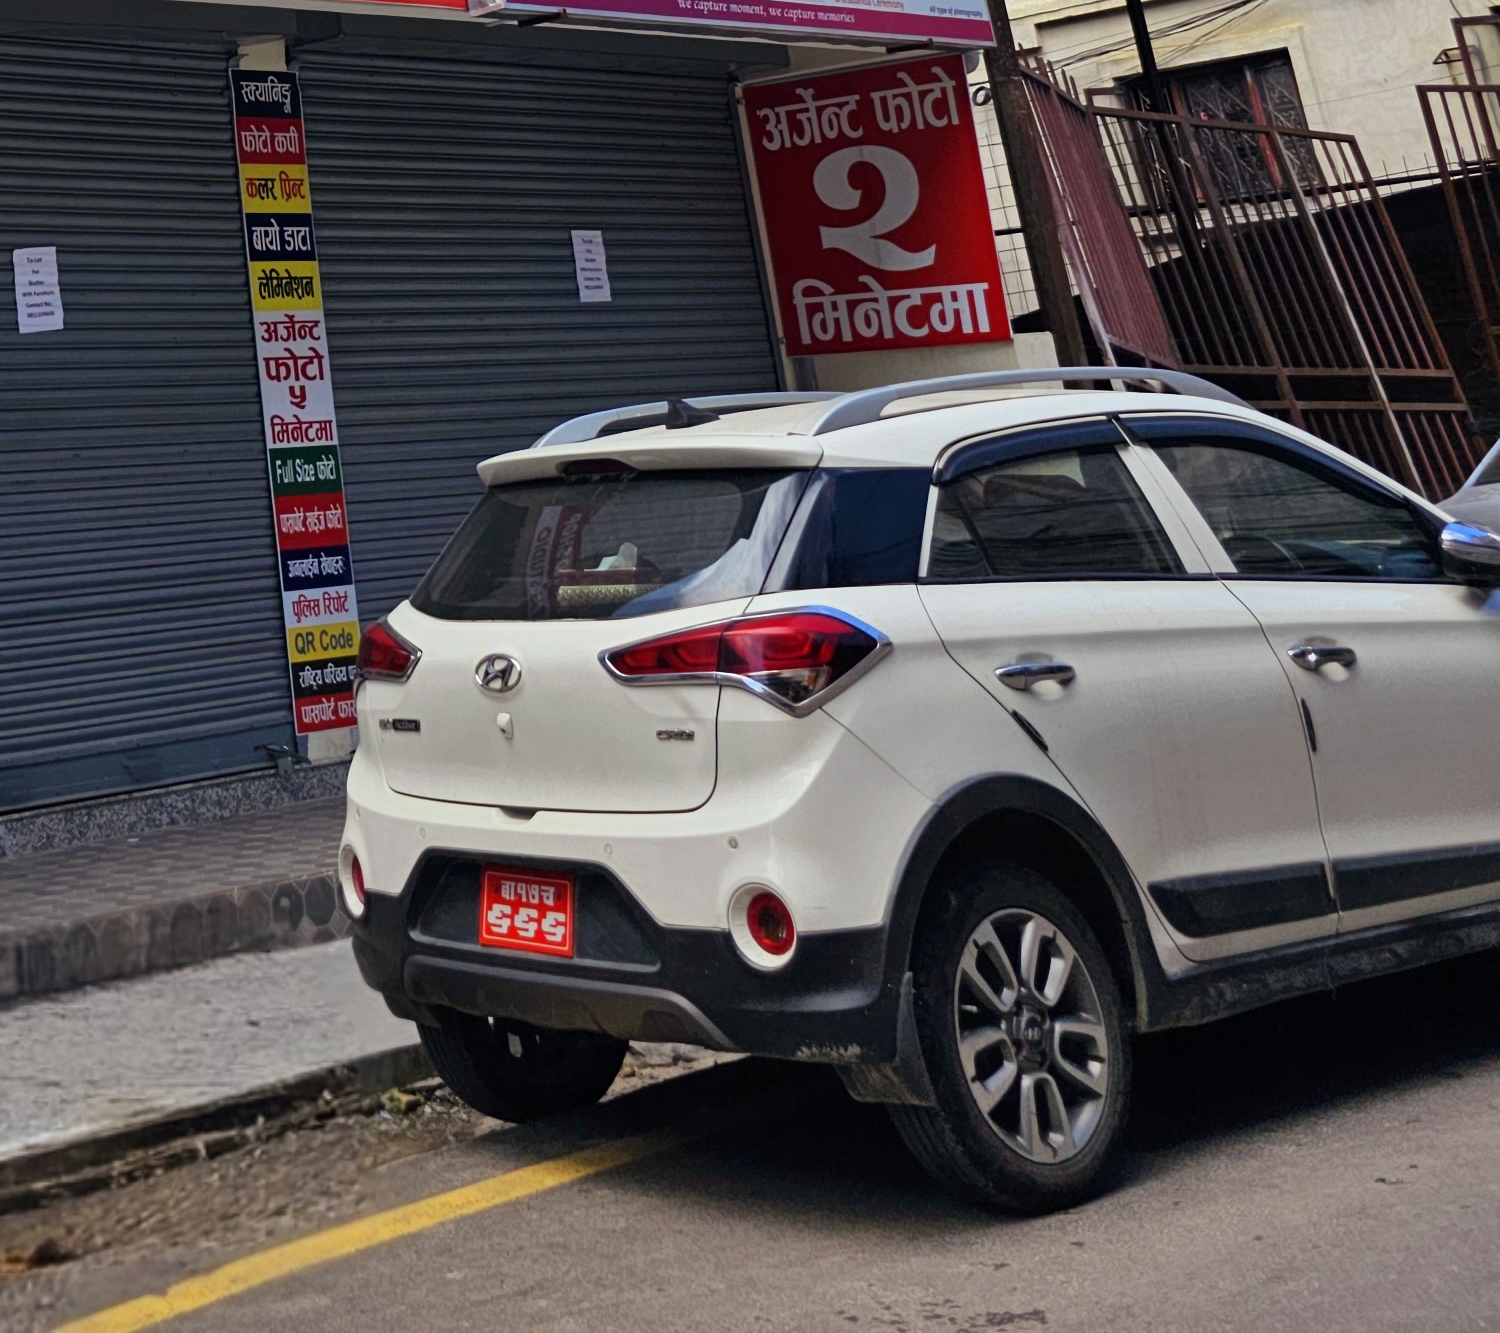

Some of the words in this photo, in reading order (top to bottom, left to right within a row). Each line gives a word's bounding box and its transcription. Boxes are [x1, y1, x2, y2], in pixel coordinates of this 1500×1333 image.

[694, 0, 727, 14] capture
[784, 8, 815, 21] capture
[756, 88, 863, 151] अर्जेन्ट
[870, 66, 959, 133] फोटो
[241, 125, 271, 153] फोटो
[274, 126, 299, 153] कपी
[245, 178, 277, 200] कलर
[279, 171, 305, 202] प्रिन्ट
[813, 145, 936, 271] २
[252, 218, 280, 251] बायो
[283, 227, 311, 251] डाटा
[258, 268, 314, 300] लेमिनेशन
[793, 275, 990, 345] मिनेटमा
[259, 314, 321, 343] अर्जेन्ट
[263, 347, 324, 382] फोटो
[289, 385, 307, 409] ५
[270, 414, 333, 444] मिनेटमा
[276, 459, 294, 483] Full
[295, 458, 315, 482] Size
[323, 590, 349, 615] रिपोर्ट
[295, 631, 316, 655] QR
[320, 627, 354, 651] Code
